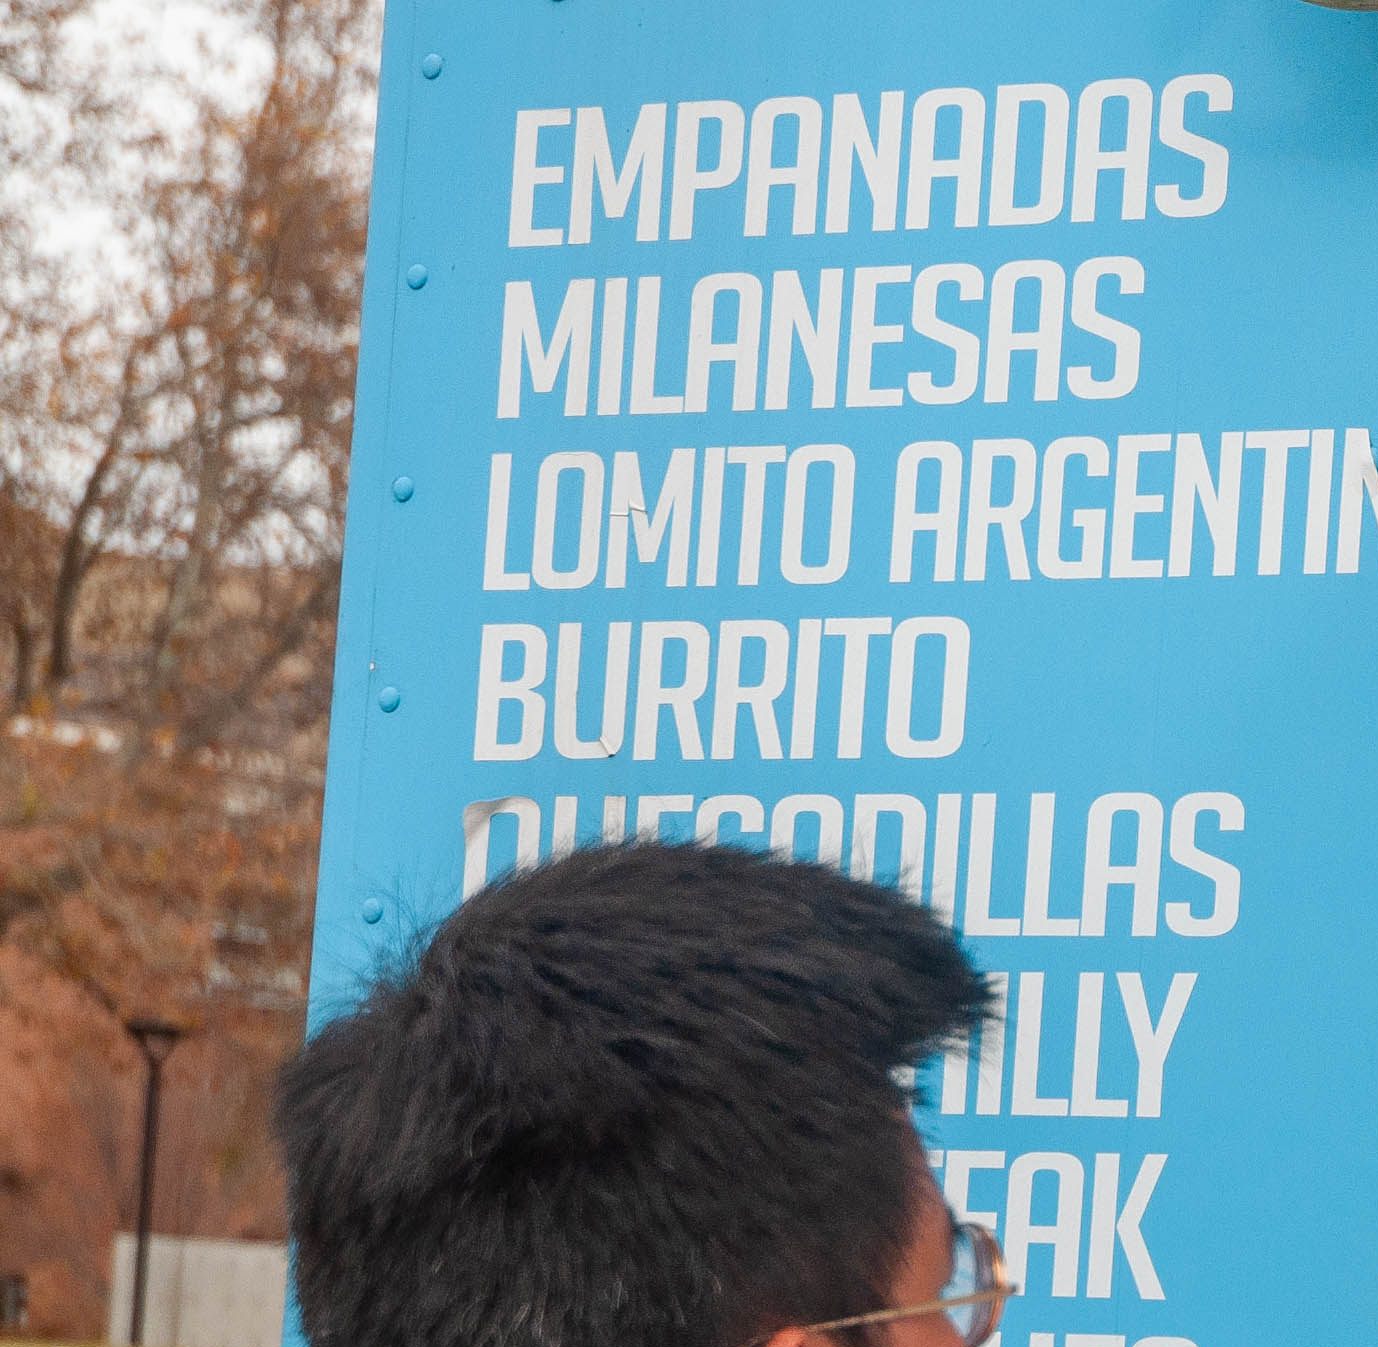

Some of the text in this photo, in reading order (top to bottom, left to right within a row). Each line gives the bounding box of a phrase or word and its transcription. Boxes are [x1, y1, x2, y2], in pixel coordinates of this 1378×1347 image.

[507, 73, 1234, 249] EMPANADAS
[496, 255, 1146, 420] MILANESAS
[482, 443, 857, 591] LOMITO
[473, 615, 971, 762] BURRITO
